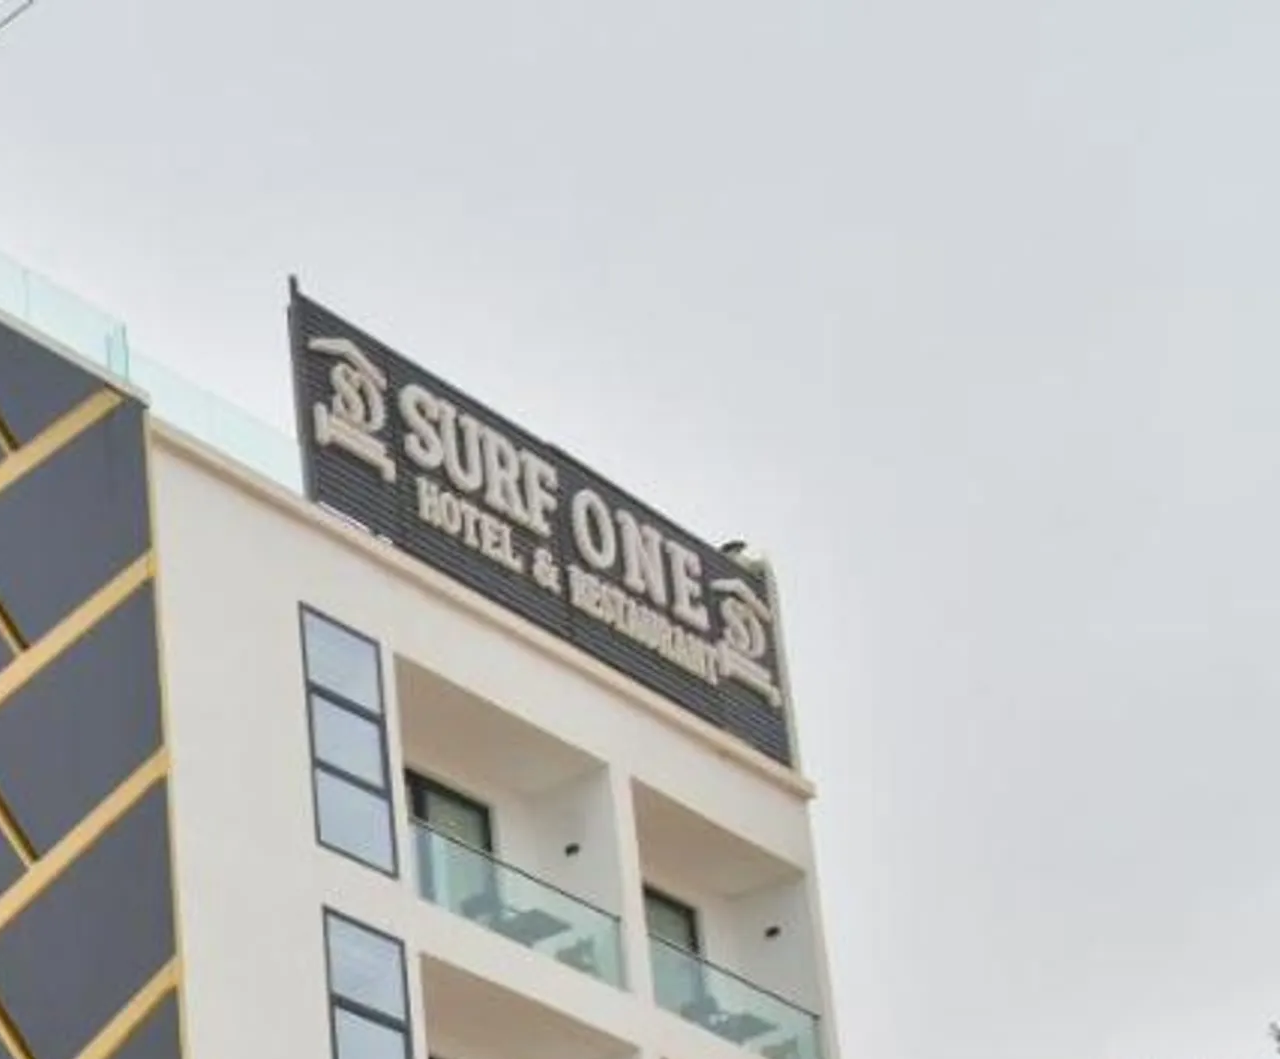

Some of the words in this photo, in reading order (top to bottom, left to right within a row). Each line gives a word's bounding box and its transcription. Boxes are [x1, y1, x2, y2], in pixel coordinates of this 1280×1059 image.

[397, 383, 558, 537] SURF
[572, 489, 710, 632] ONE
[416, 476, 523, 574] HOTEL
[533, 548, 561, 594] &
[567, 564, 719, 685] RESTAURANT
